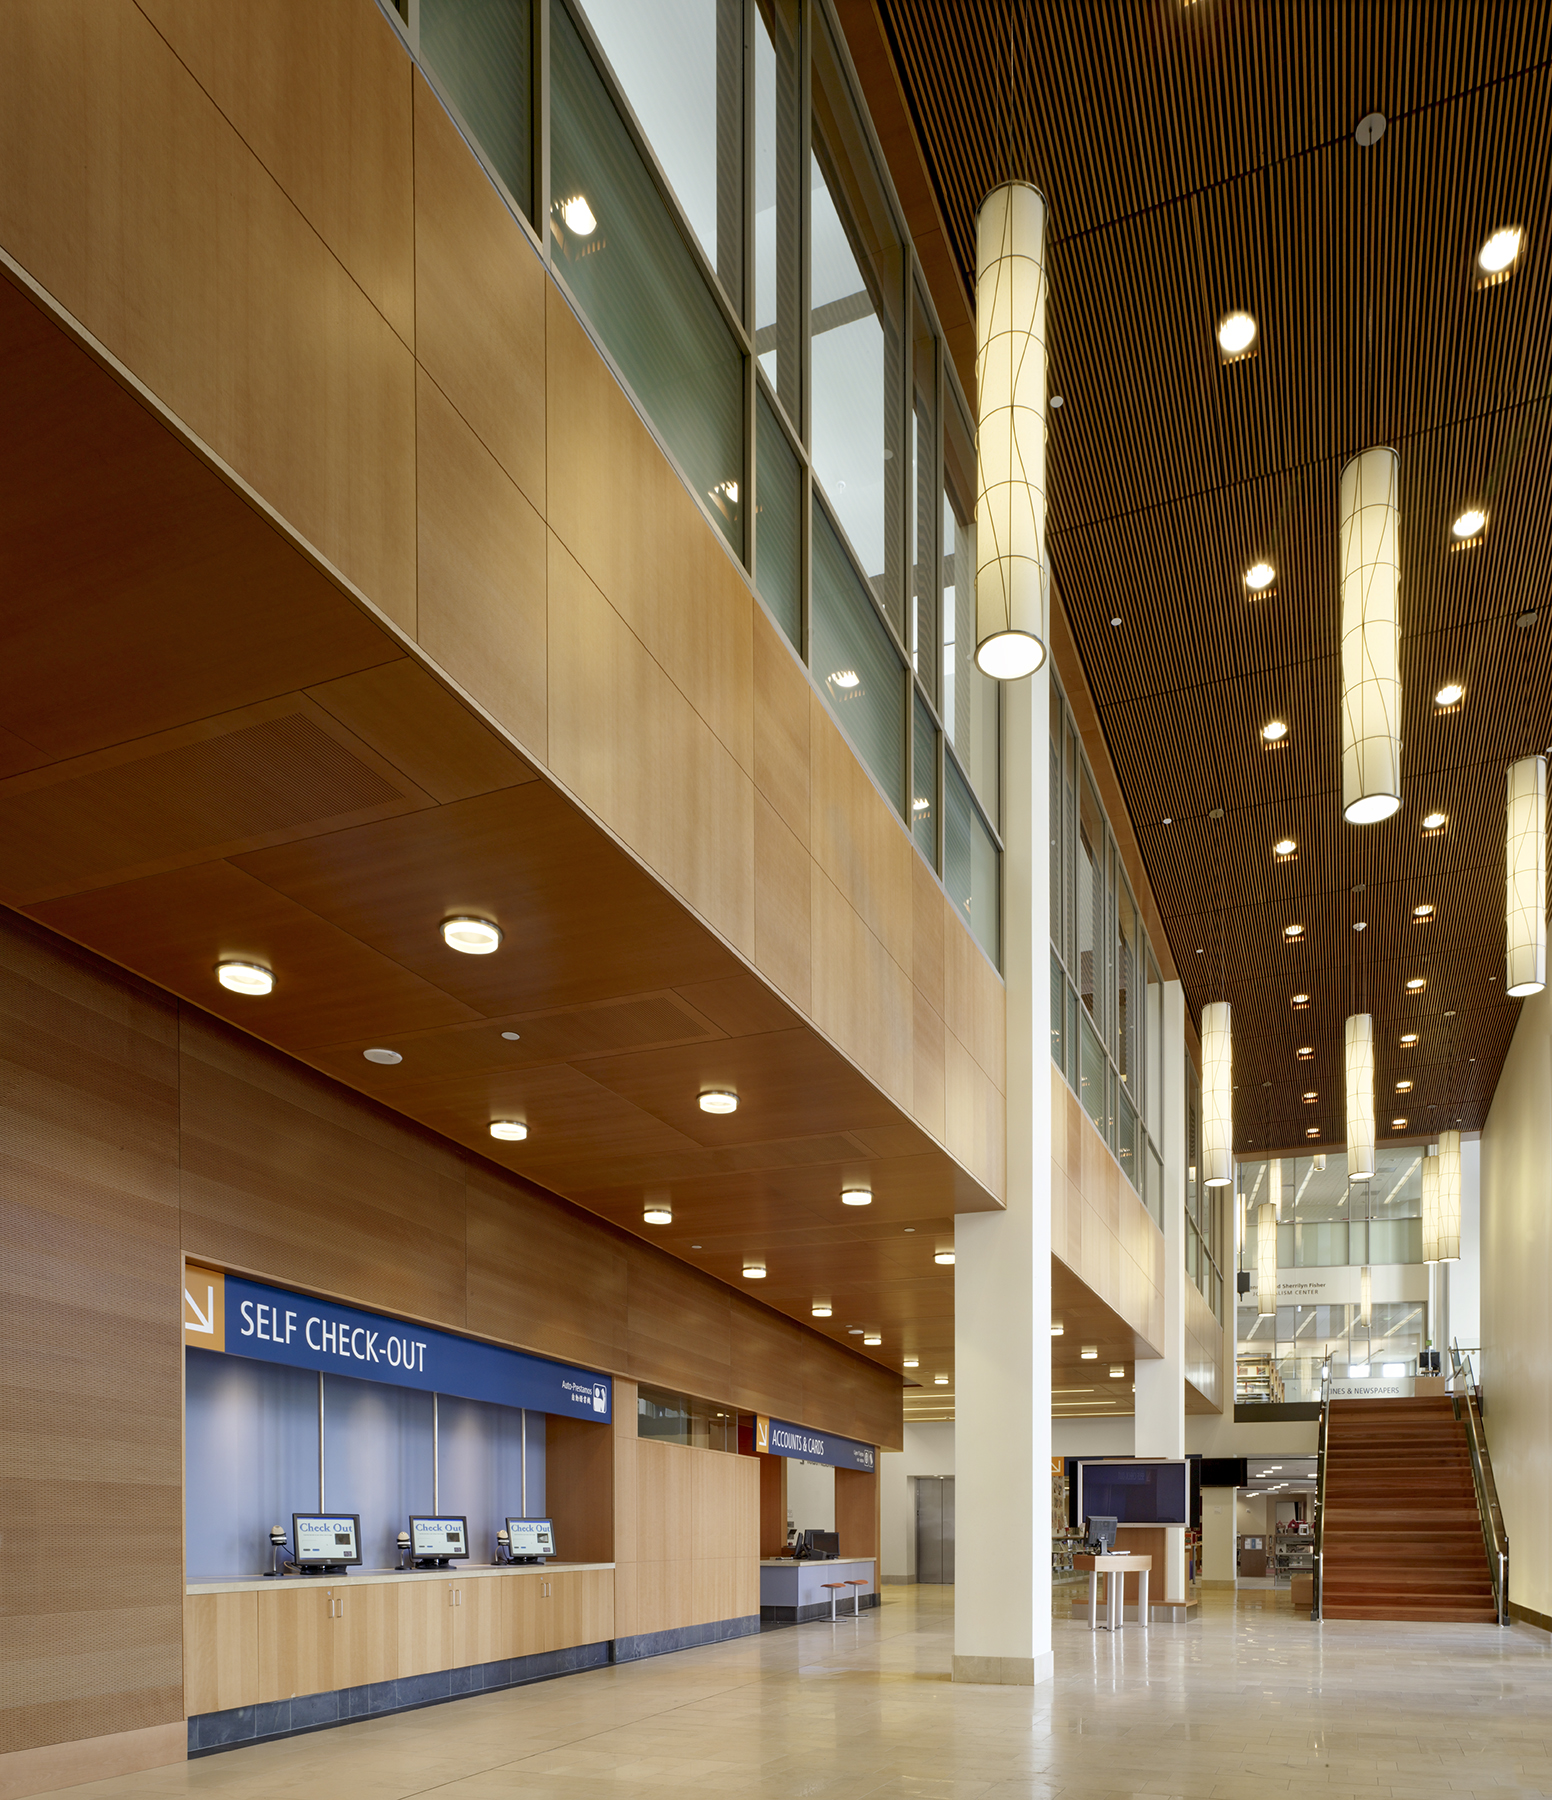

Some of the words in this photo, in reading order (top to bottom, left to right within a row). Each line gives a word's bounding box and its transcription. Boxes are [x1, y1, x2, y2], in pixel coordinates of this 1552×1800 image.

[240, 1300, 297, 1344] SELF
[305, 1316, 427, 1372] CHECK-OUT
[1354, 1386, 1400, 1395] NEWSPAPERS
[772, 1430, 802, 1450] ACCOUNTS
[802, 1436, 808, 1452] &
[808, 1438, 824, 1455] CARDS
[299, 1522, 331, 1532] Check
[333, 1522, 353, 1533] Out
[415, 1523, 443, 1532] Check
[444, 1523, 462, 1532] Out
[511, 1523, 535, 1533] Check
[536, 1523, 551, 1533] Out
